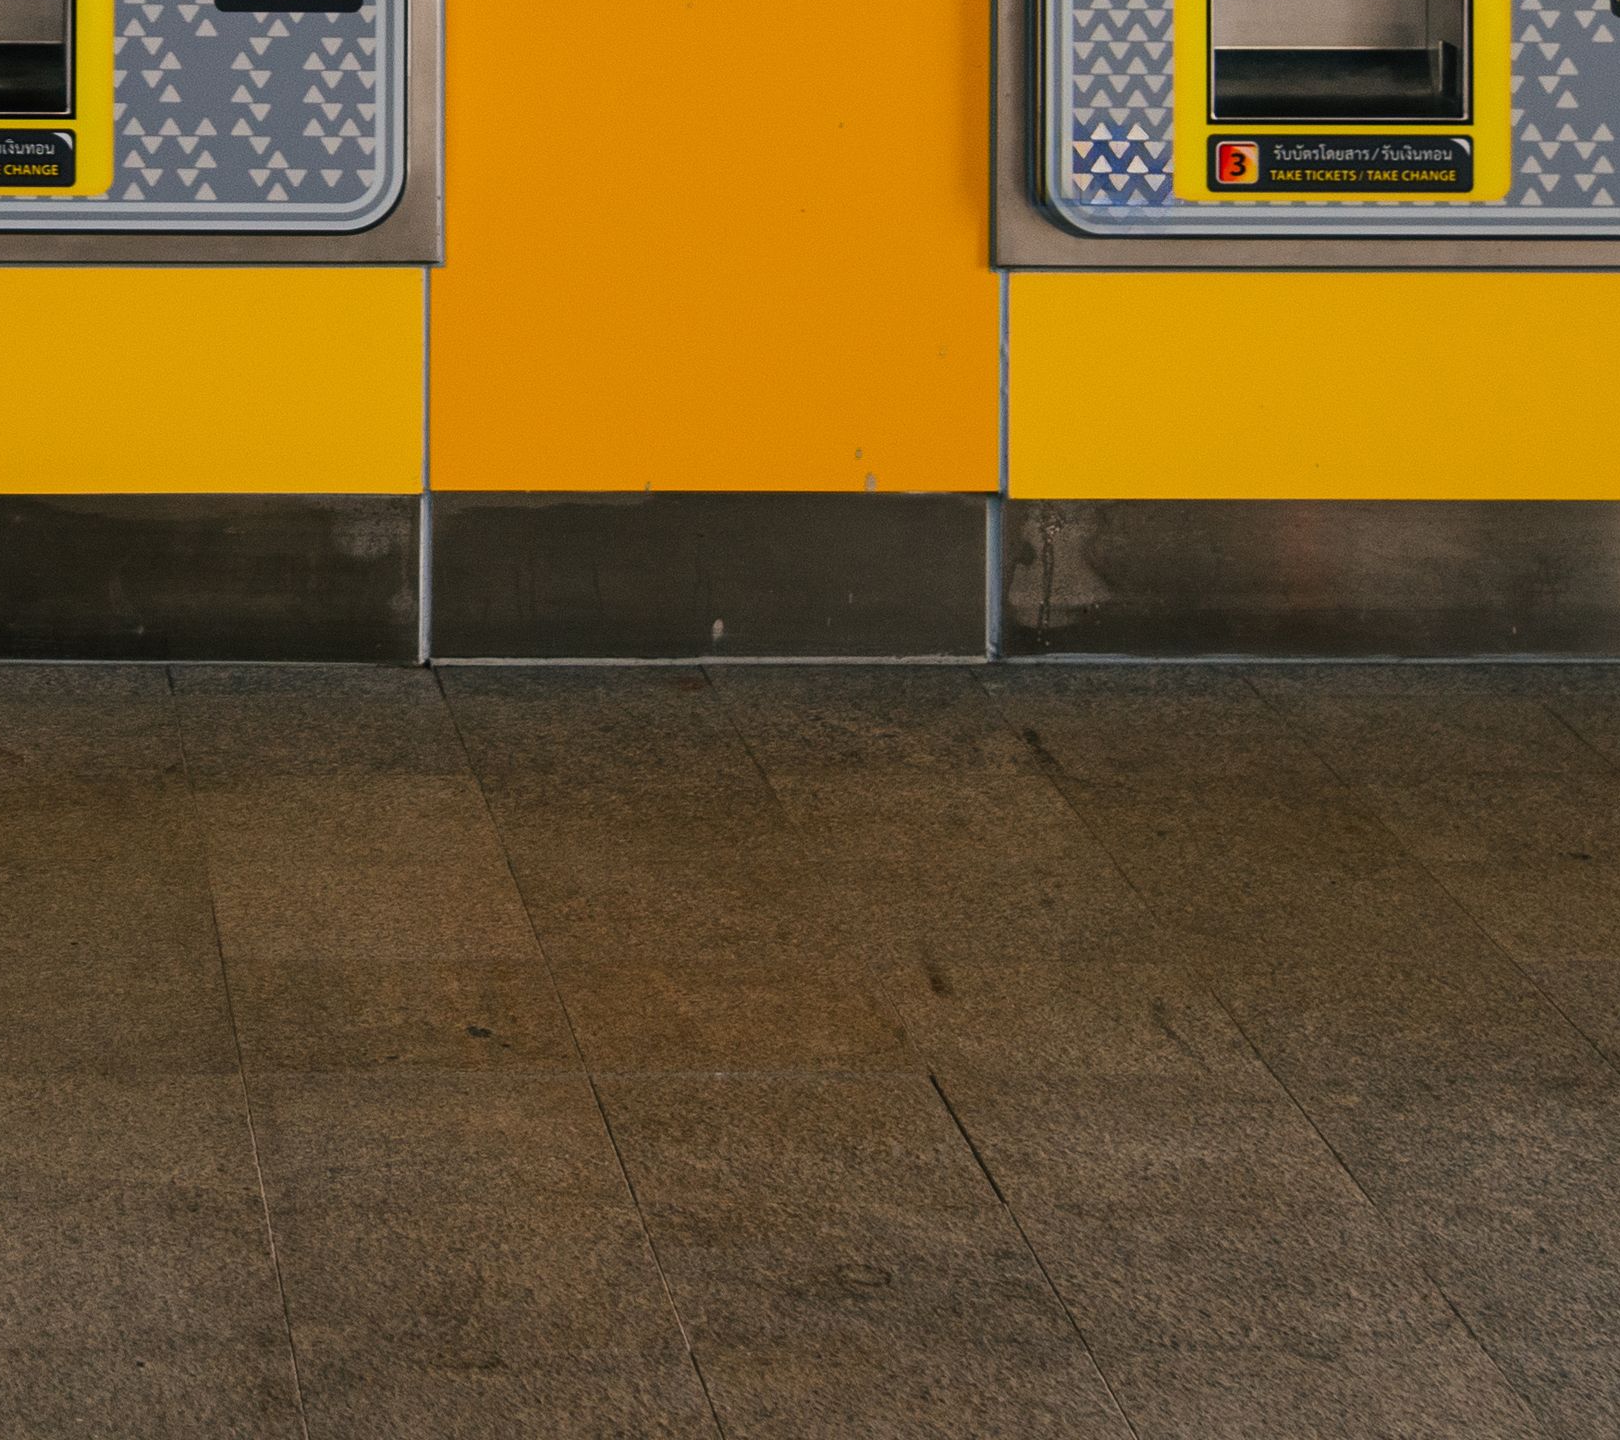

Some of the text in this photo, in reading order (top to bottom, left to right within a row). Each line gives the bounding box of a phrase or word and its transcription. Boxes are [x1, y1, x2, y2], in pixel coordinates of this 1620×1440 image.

[1272, 143, 1370, 161] รับบัตรโดยสาร
[1382, 145, 1454, 161] รับเงินทอน
[4, 164, 59, 176] CHANGE
[1229, 153, 1247, 176] 3
[1269, 170, 1302, 181] TAKE
[1305, 170, 1357, 181] TICKETS
[1367, 170, 1399, 181] TAKE
[1402, 170, 1457, 182] CHANGE
